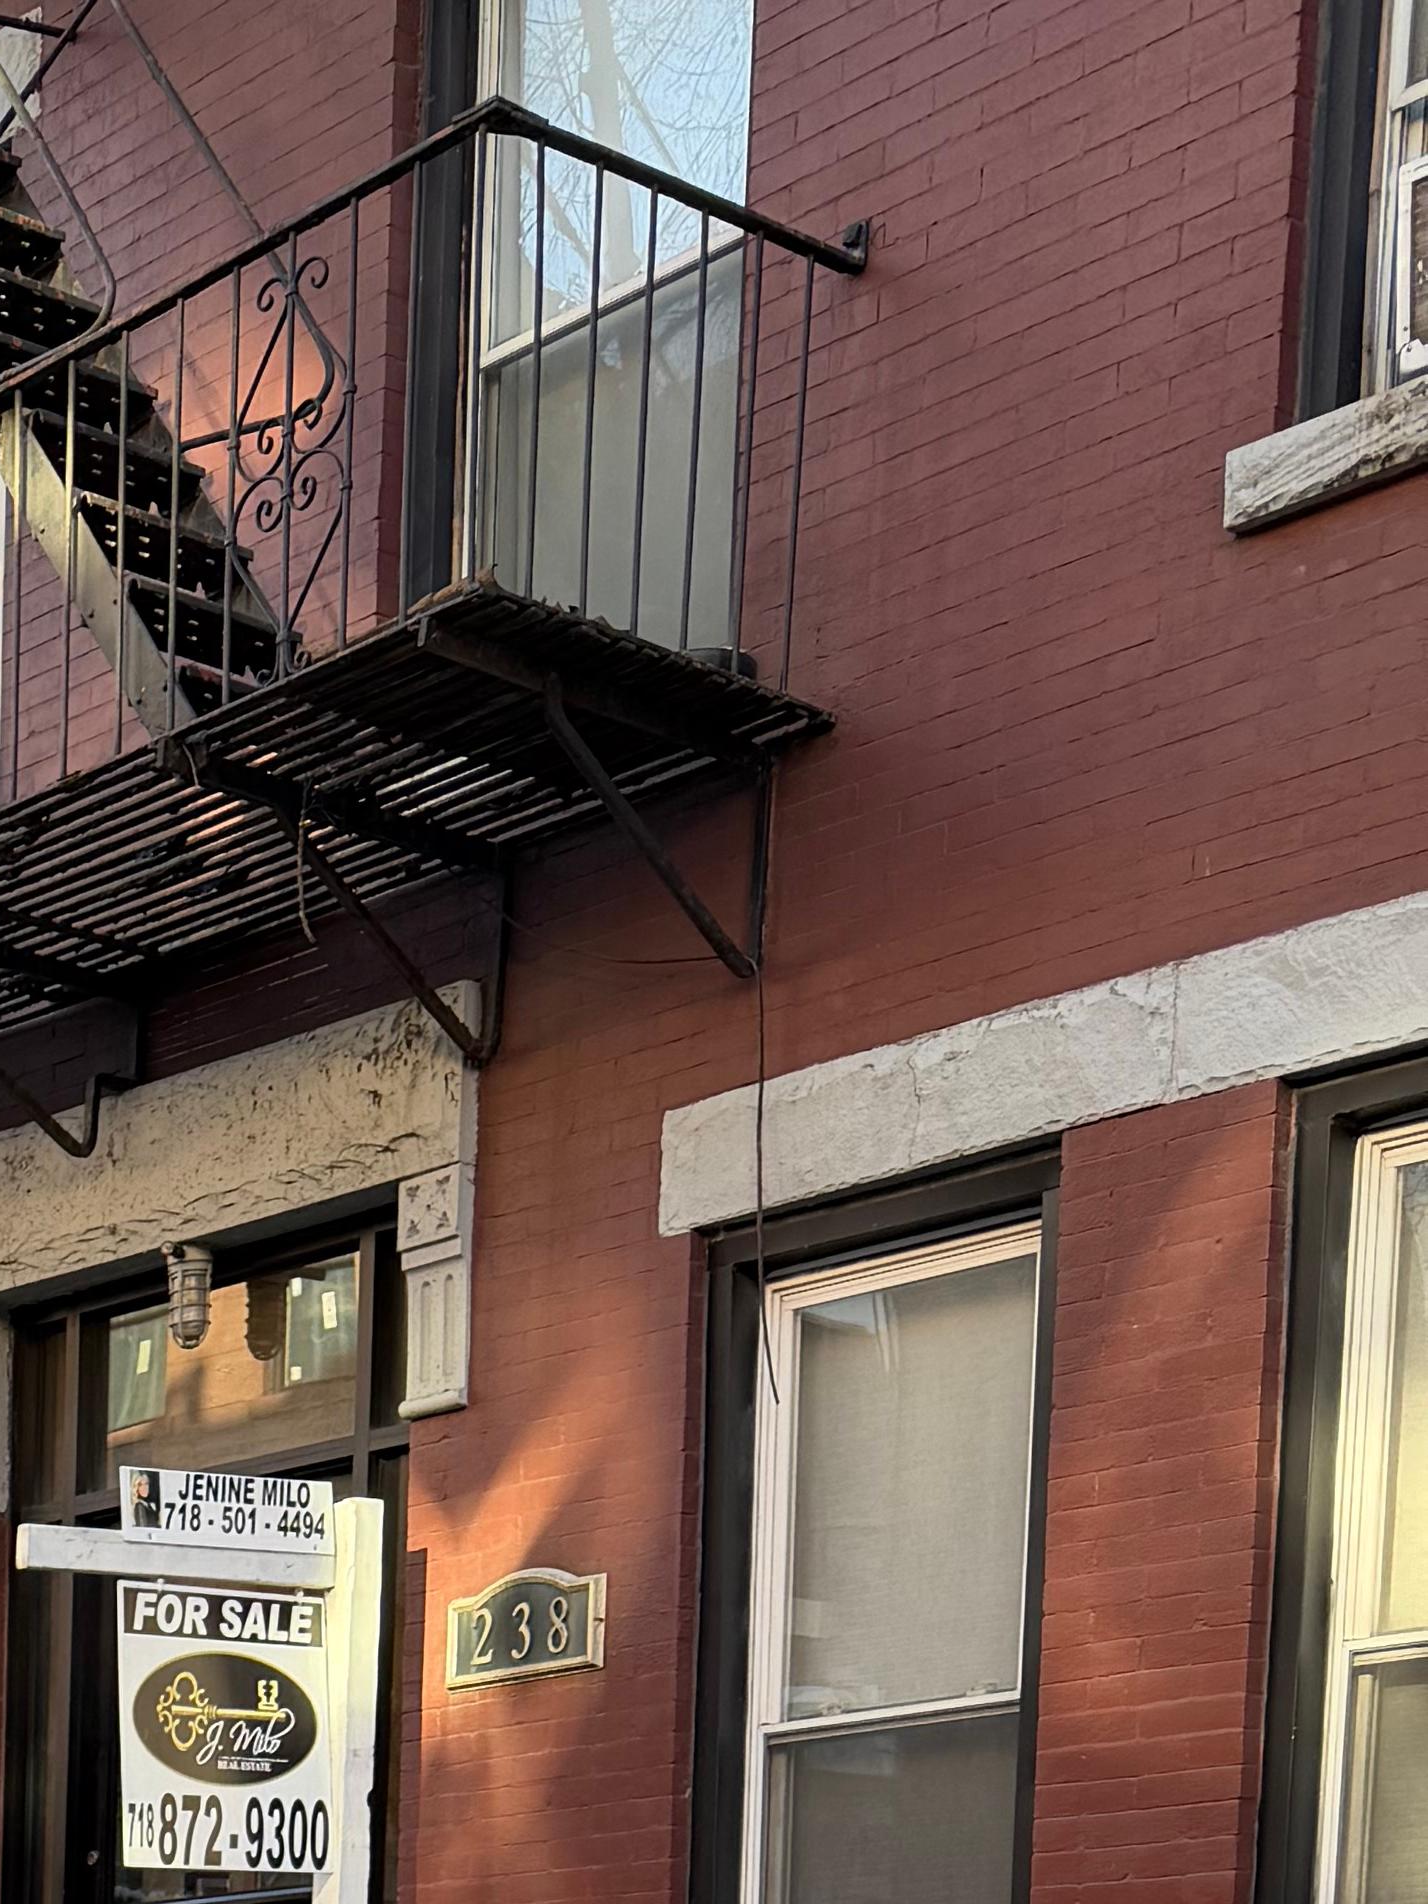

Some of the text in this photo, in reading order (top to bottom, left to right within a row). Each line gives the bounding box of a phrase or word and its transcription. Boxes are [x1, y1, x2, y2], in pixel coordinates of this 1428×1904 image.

[178, 1473, 311, 1508] JENINE MILO
[164, 1502, 201, 1532] 718
[221, 1506, 257, 1535] 501
[277, 1510, 325, 1540] 4494
[133, 1592, 314, 1644] FOR SALE
[470, 1596, 568, 1665] 238
[128, 1802, 154, 1848] 718
